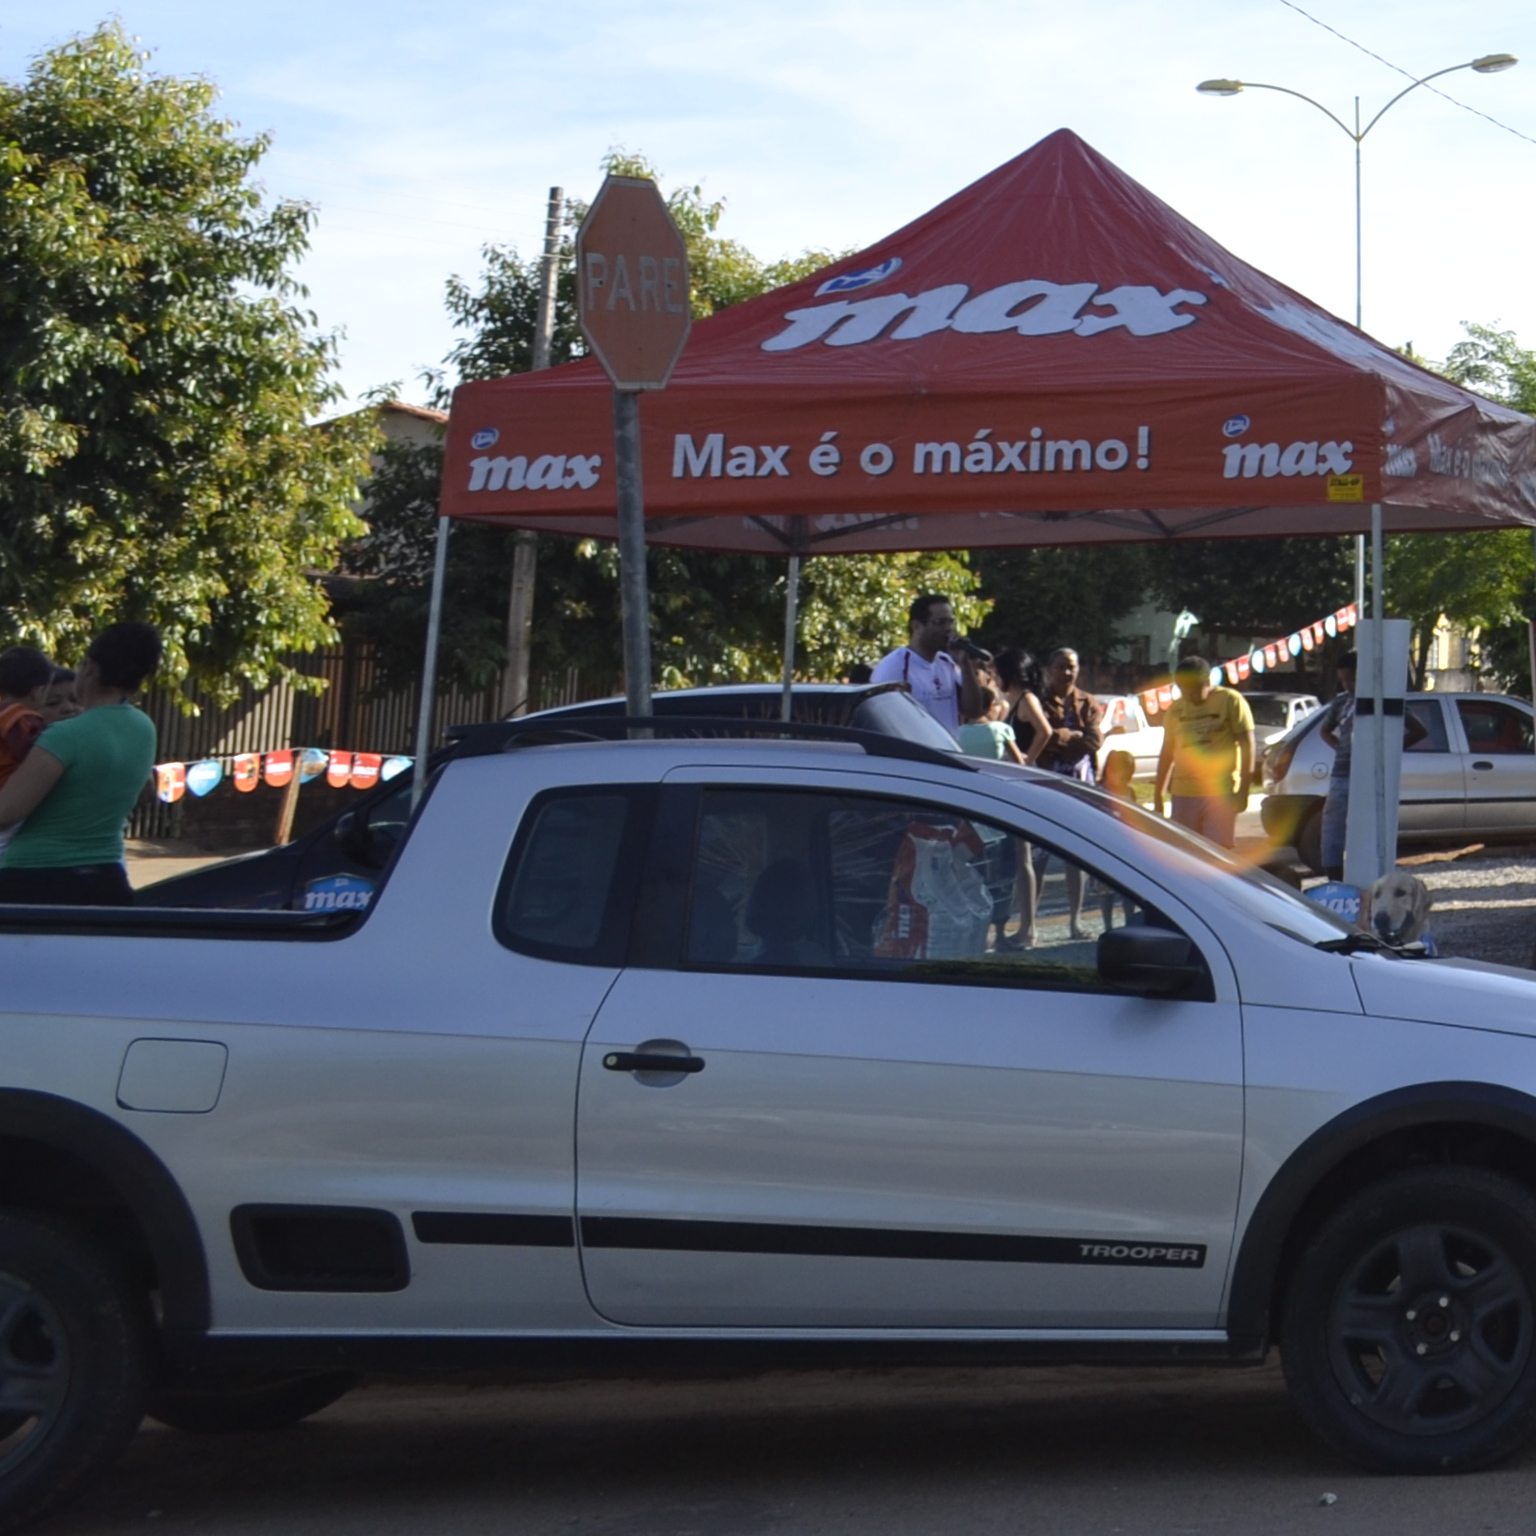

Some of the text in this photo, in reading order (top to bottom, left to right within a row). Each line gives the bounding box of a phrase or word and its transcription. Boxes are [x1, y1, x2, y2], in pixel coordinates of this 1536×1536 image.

[585, 252, 684, 313] PARE
[760, 279, 1208, 352] max
[672, 426, 1150, 478] Max é o máximo!
[1222, 440, 1353, 479] max
[468, 454, 601, 492] max
[305, 891, 373, 910] max
[1080, 1244, 1199, 1260] TROOPER
